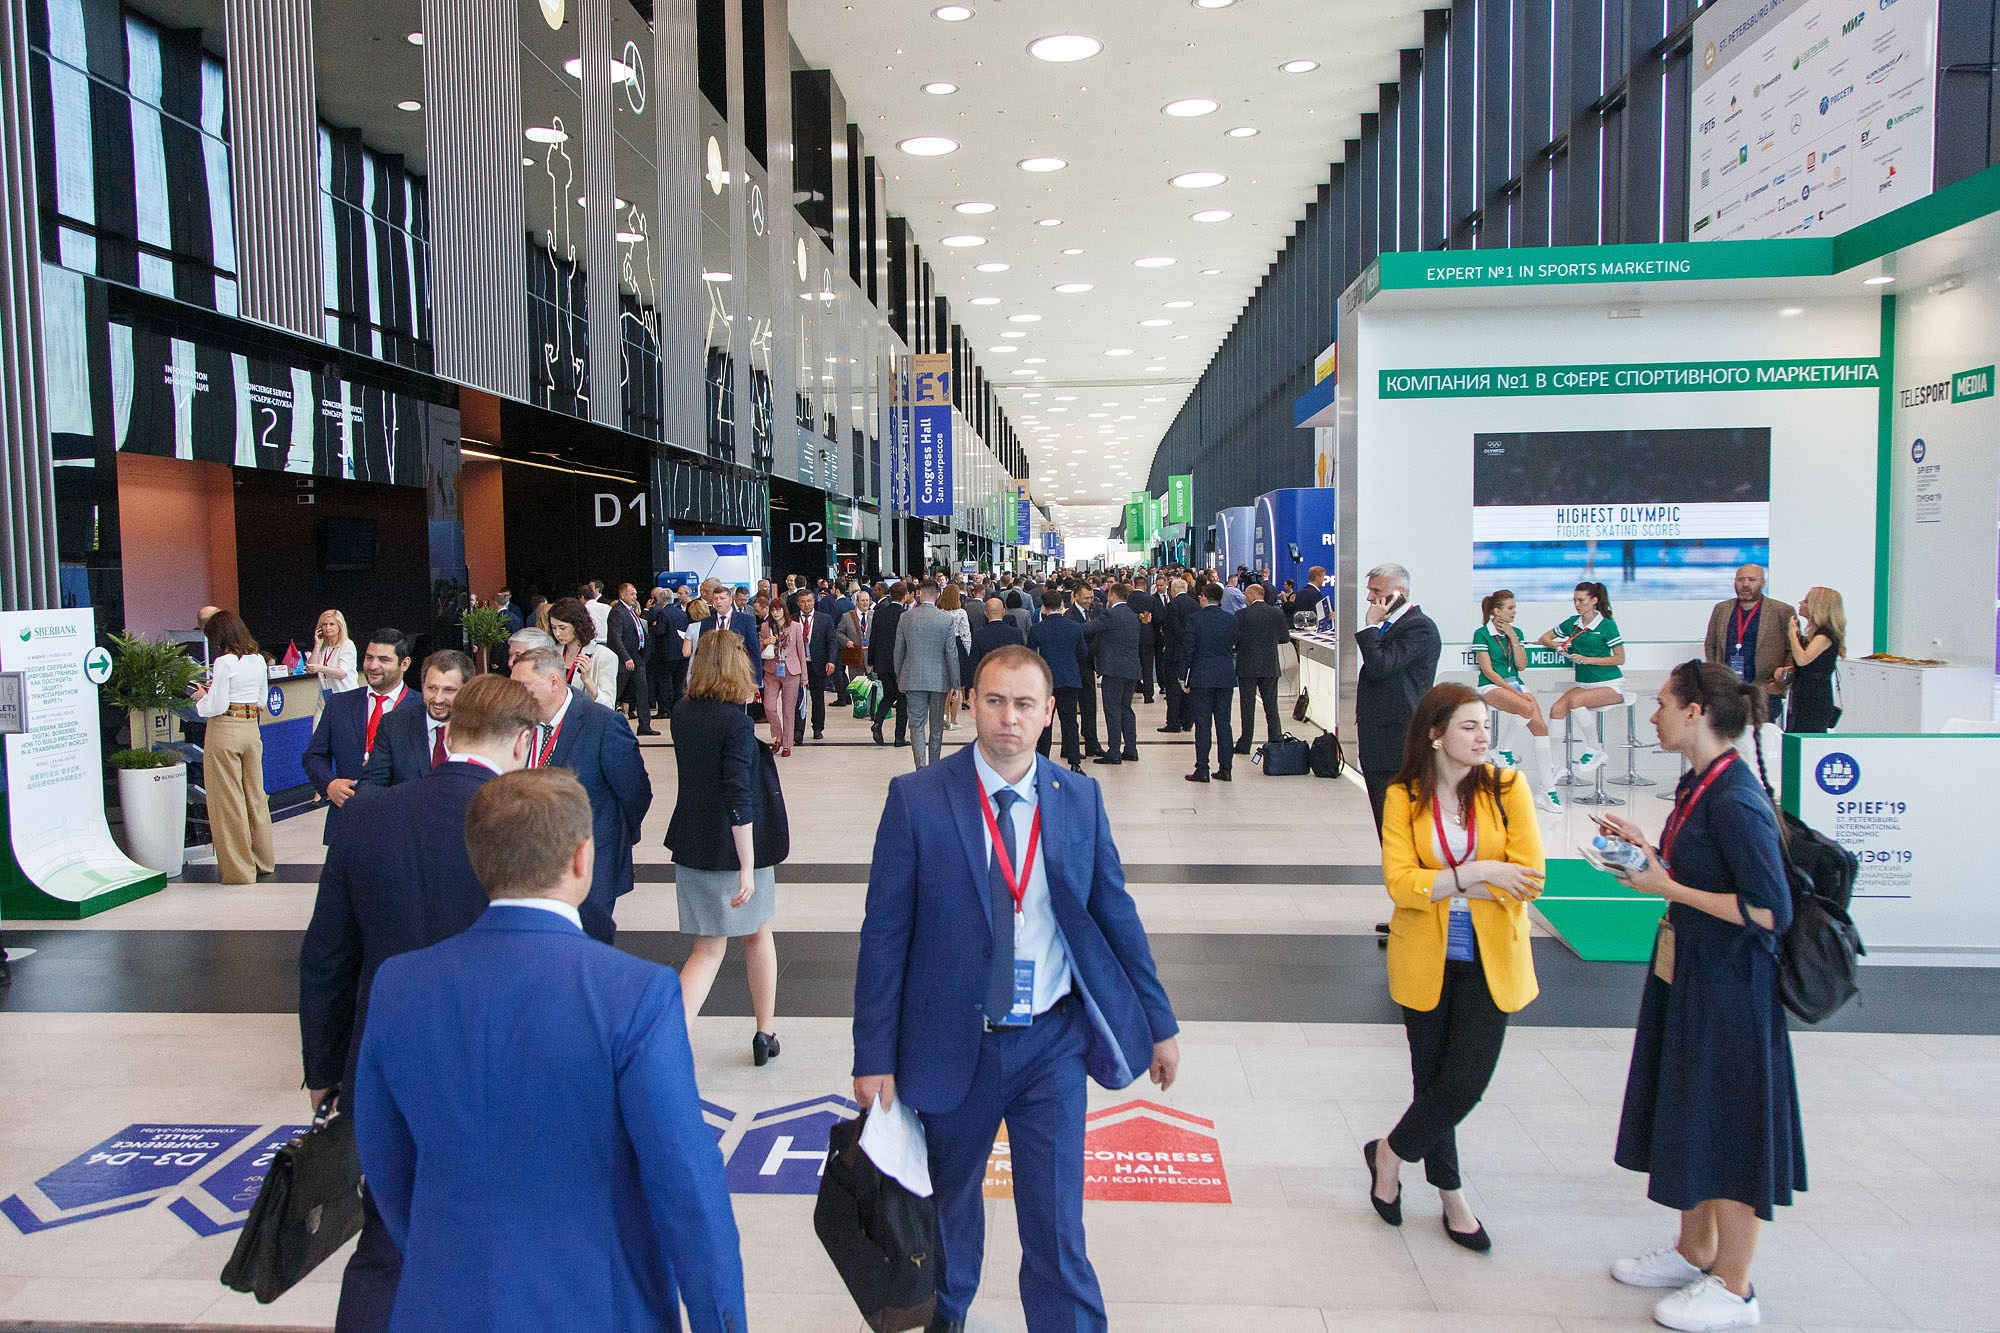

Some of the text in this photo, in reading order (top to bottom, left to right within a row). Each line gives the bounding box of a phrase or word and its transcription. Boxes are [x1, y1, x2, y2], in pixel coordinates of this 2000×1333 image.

[1728, 4, 1769, 45] PETERSBURG
[1842, 11, 1865, 37] МИР
[1704, 117, 1716, 134] ВТБ
[1427, 266, 1483, 280] EXPERT
[1519, 265, 1534, 278] IN
[1538, 263, 1597, 276] SPORTS
[1601, 260, 1691, 274] MARKETING
[165, 365, 208, 381] INFORMATION
[1386, 374, 1490, 392] КОМПАНИЯ
[1536, 372, 1547, 388] В
[1553, 371, 1610, 387] СФЕРЕ
[1615, 367, 1750, 386] СПОРТИВНОГО
[1756, 364, 1880, 382] МАРКЕТИНГА
[164, 376, 209, 392] ИНФОРМАЦИЯ
[916, 371, 949, 402] E1
[1900, 373, 1988, 408] TELESPORT MEDIA
[272, 388, 292, 399] SERVICE
[261, 408, 278, 448] 2
[920, 418, 934, 504] Congress Hall
[936, 434, 946, 504] Зал конгрессов
[594, 493, 647, 527] D1
[1557, 506, 1680, 524] HIGHEST OLYMPIC
[790, 522, 823, 543] D2
[1557, 523, 1680, 537] FIGURE SKATING SCORES
[34, 625, 77, 636] SBERBANK
[1531, 651, 1566, 664] MEDIA
[156, 714, 168, 728] EY
[110, 1141, 220, 1150] CONFERENCE
[1115, 1164, 1182, 1175] HALL
[1113, 1176, 1222, 1186] КОНГРЕССОВ
